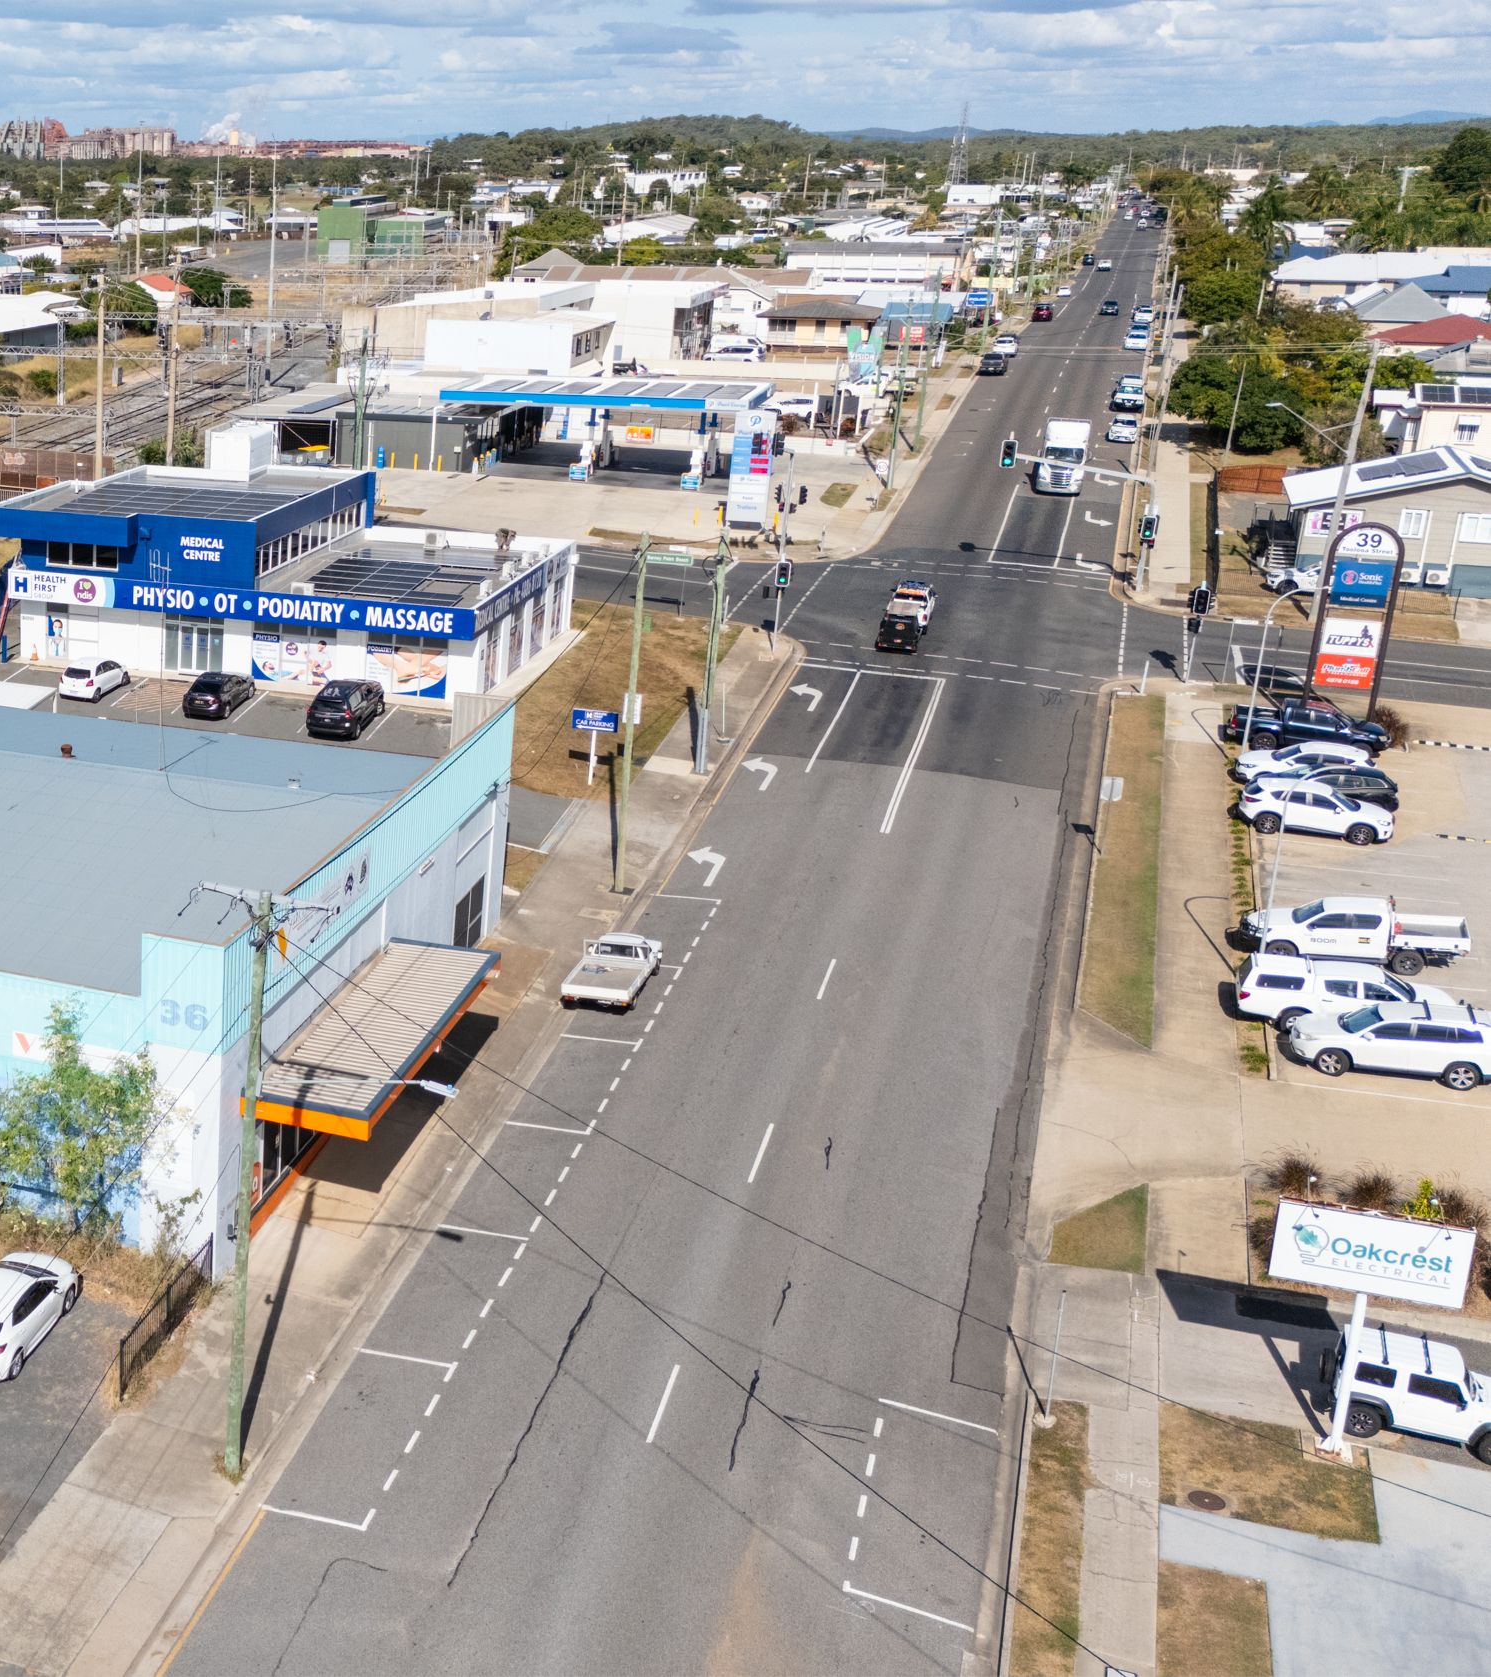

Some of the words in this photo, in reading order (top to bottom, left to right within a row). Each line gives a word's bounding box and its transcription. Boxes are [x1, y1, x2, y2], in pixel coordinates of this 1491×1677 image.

[848, 352, 875, 361] VISION
[180, 536, 224, 550] MEDICAL
[1356, 533, 1382, 548] 39
[183, 549, 221, 562] CENTRE
[34, 574, 67, 584] HEALTH
[1359, 572, 1384, 582] Sonic
[34, 583, 57, 593] FIRST
[76, 591, 93, 600] ndis
[133, 586, 194, 610] PHYSIO
[214, 593, 238, 613] OT
[258, 597, 345, 624] PODIATRY
[365, 607, 454, 633] MASSAGE
[255, 634, 279, 642] PHYSIO
[589, 720, 615, 728] PARKING
[160, 998, 208, 1031] 36
[1331, 1238, 1452, 1273] Oakcrest
[1332, 1259, 1450, 1285] ELECTRICAL
